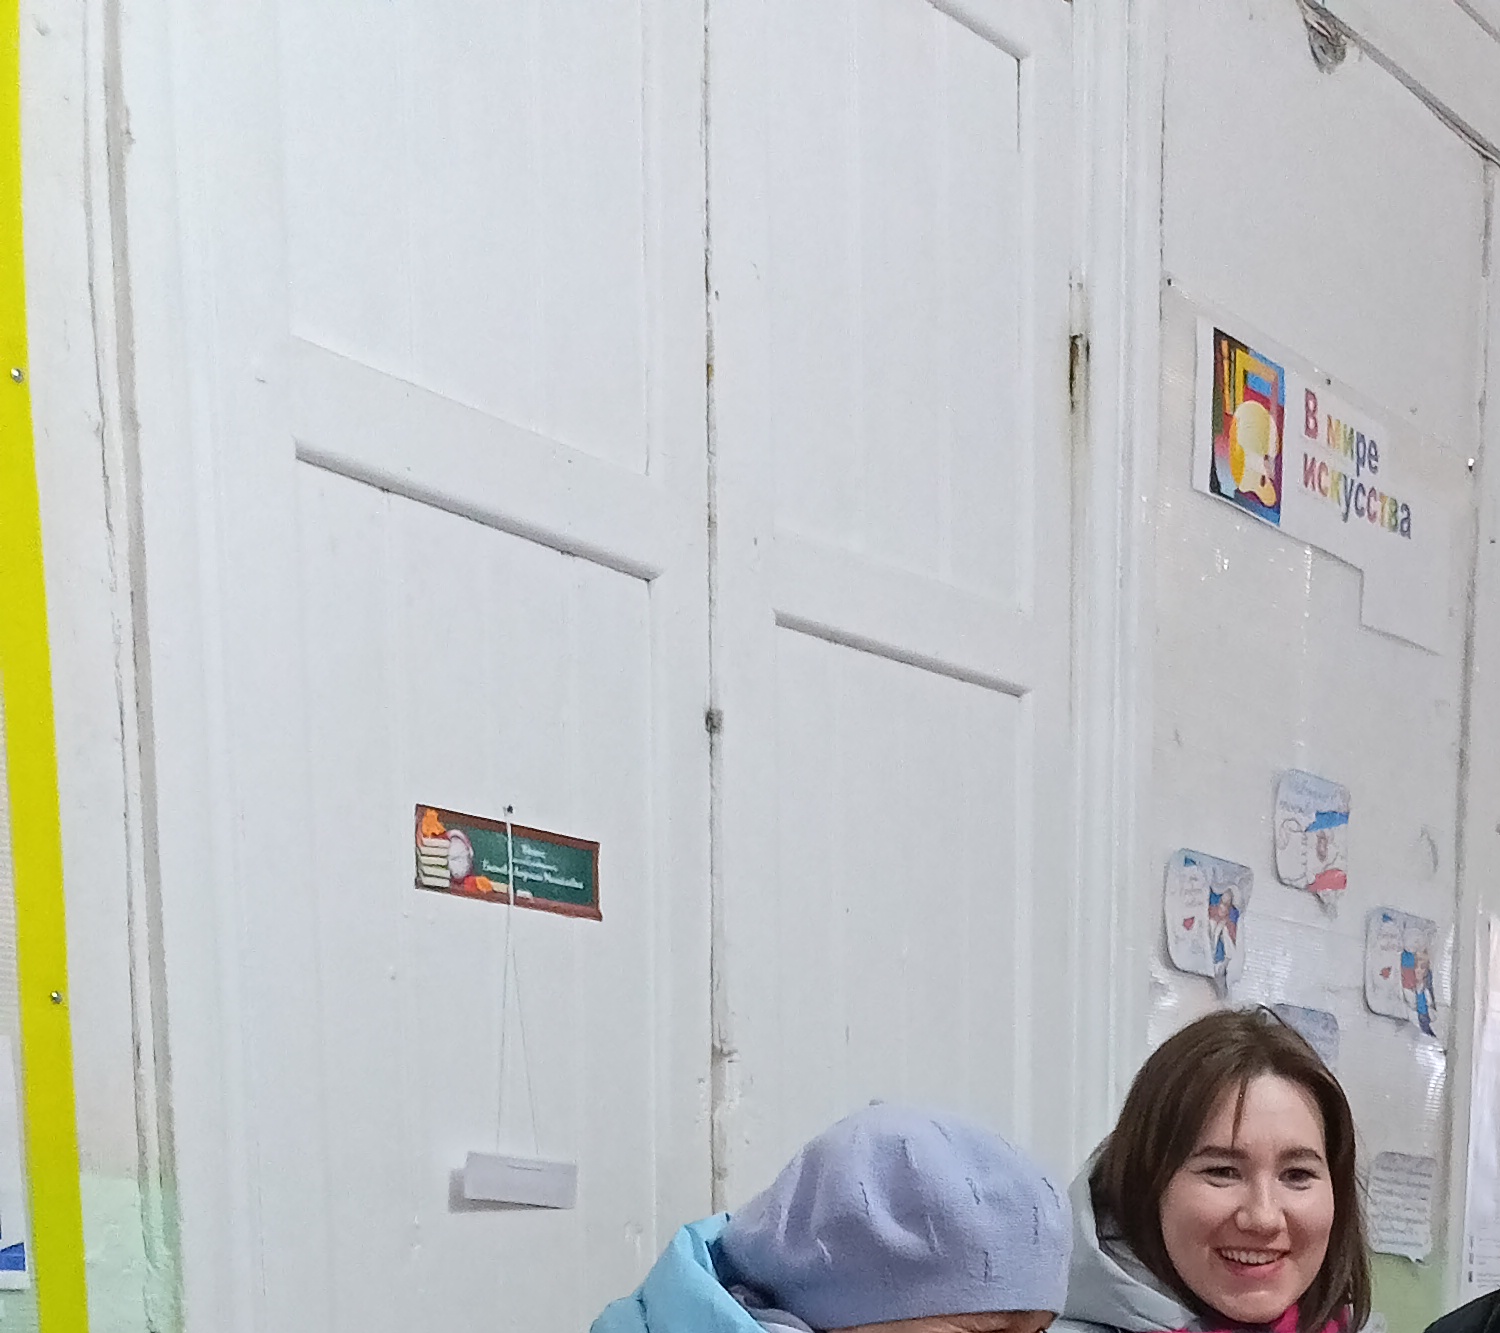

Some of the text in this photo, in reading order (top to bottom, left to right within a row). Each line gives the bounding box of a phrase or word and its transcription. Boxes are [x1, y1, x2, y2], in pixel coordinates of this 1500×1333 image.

[1304, 387, 1380, 478] В мире
[1302, 451, 1412, 540] искусства
